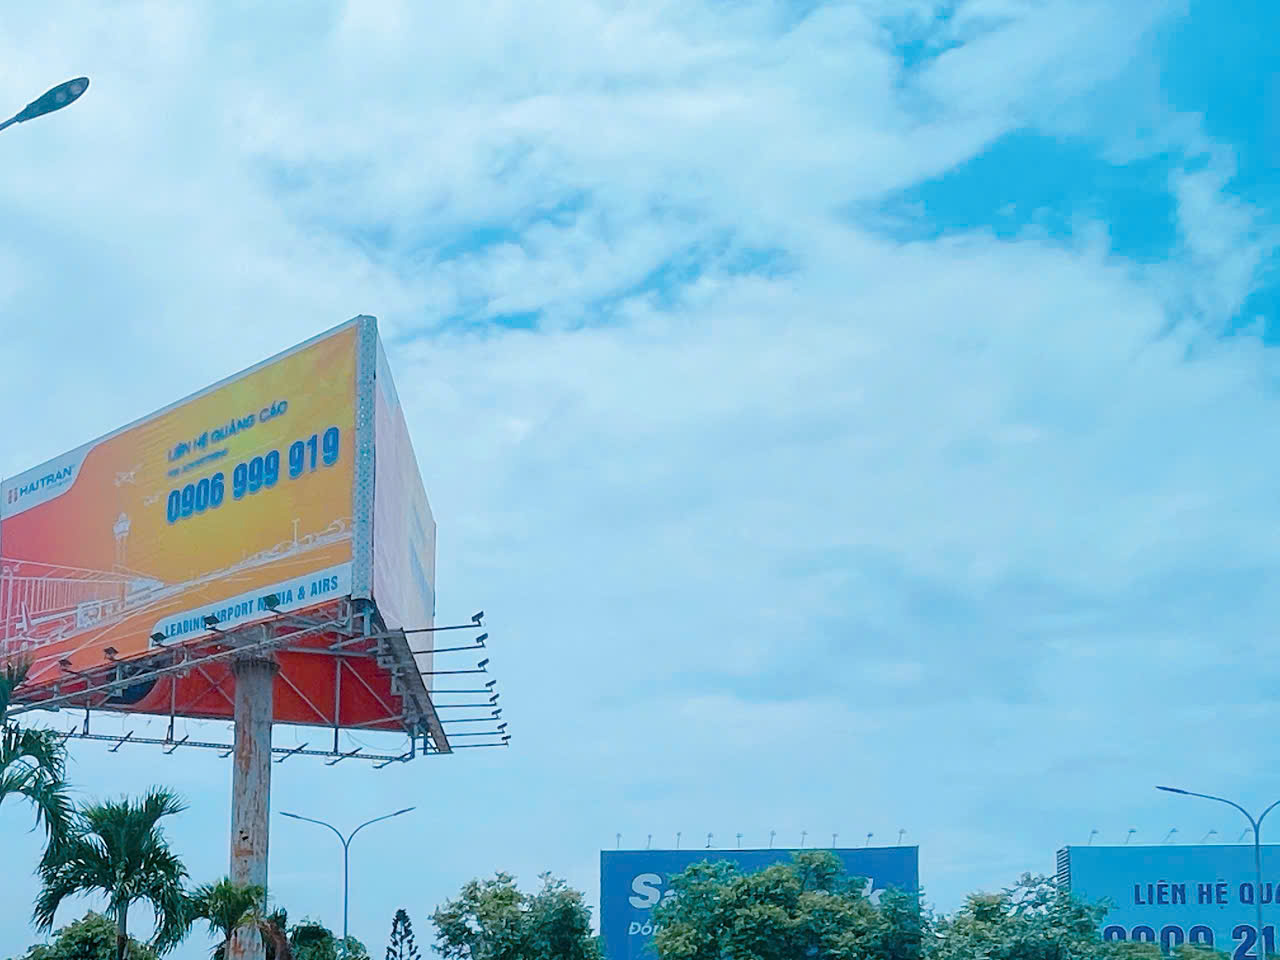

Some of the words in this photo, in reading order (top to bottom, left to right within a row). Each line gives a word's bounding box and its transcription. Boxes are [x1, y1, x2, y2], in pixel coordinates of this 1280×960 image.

[166, 471, 225, 525] 0906
[232, 450, 280, 500] 999
[288, 426, 340, 479] 919
[297, 585, 306, 600] &
[310, 575, 338, 597] AIRS
[1134, 879, 1186, 905] LIÊN
[1198, 878, 1228, 910] HỆ
